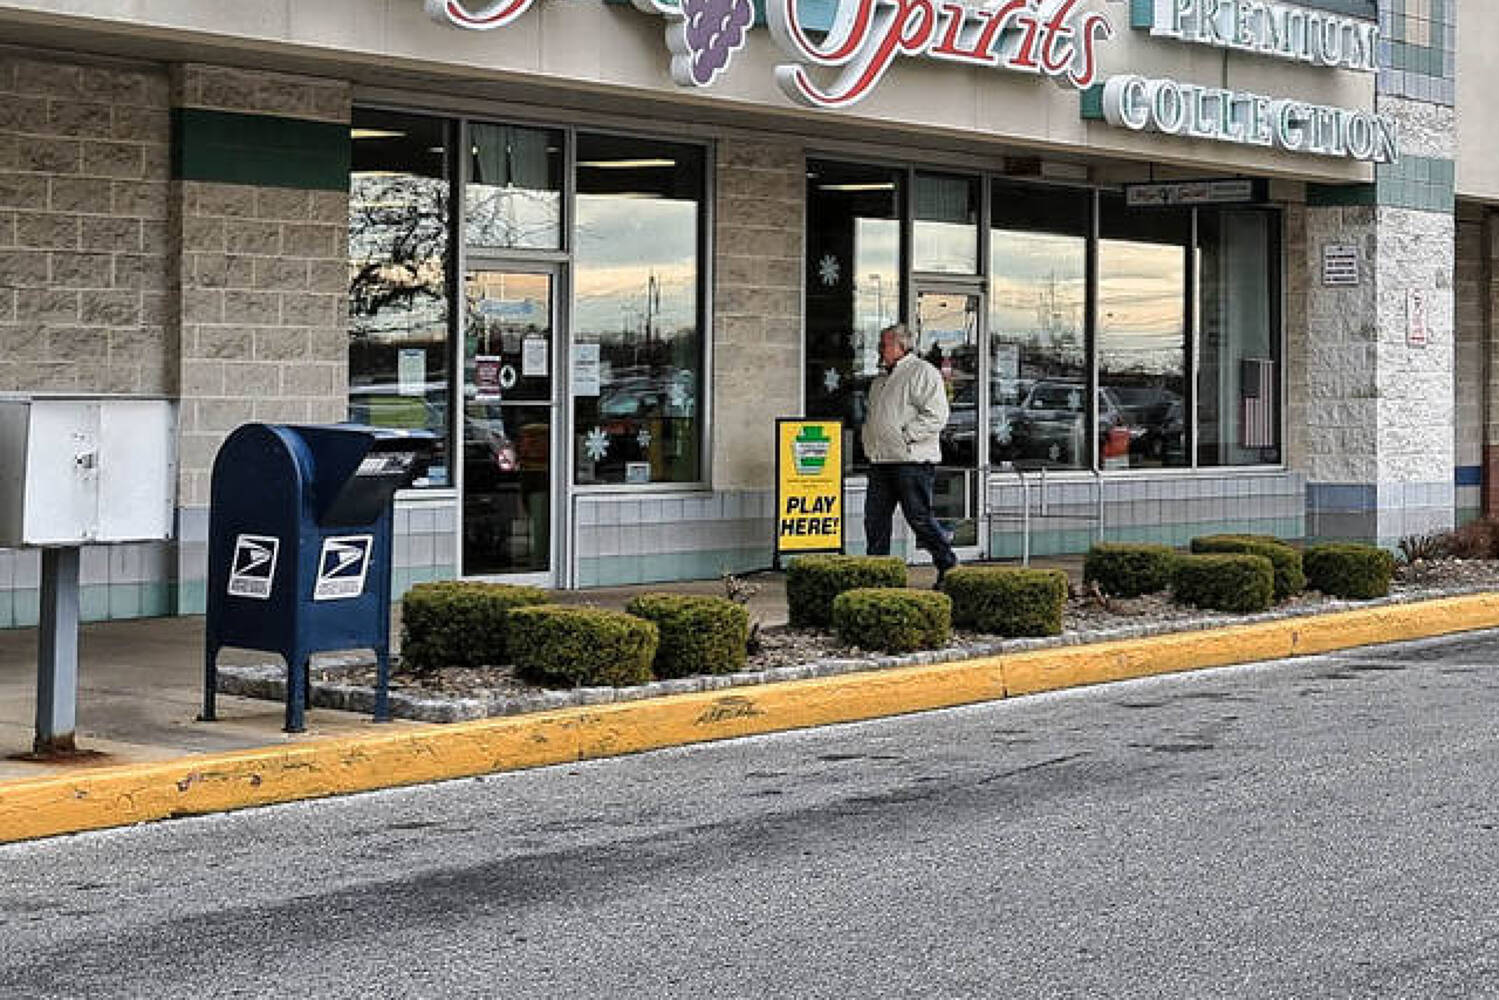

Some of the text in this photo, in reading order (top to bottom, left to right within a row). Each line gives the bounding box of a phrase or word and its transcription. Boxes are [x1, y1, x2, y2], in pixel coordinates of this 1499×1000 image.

[1104, 74, 1399, 163] COLLECTION
[786, 496, 837, 514] PLAY
[781, 517, 839, 536] HERE!
